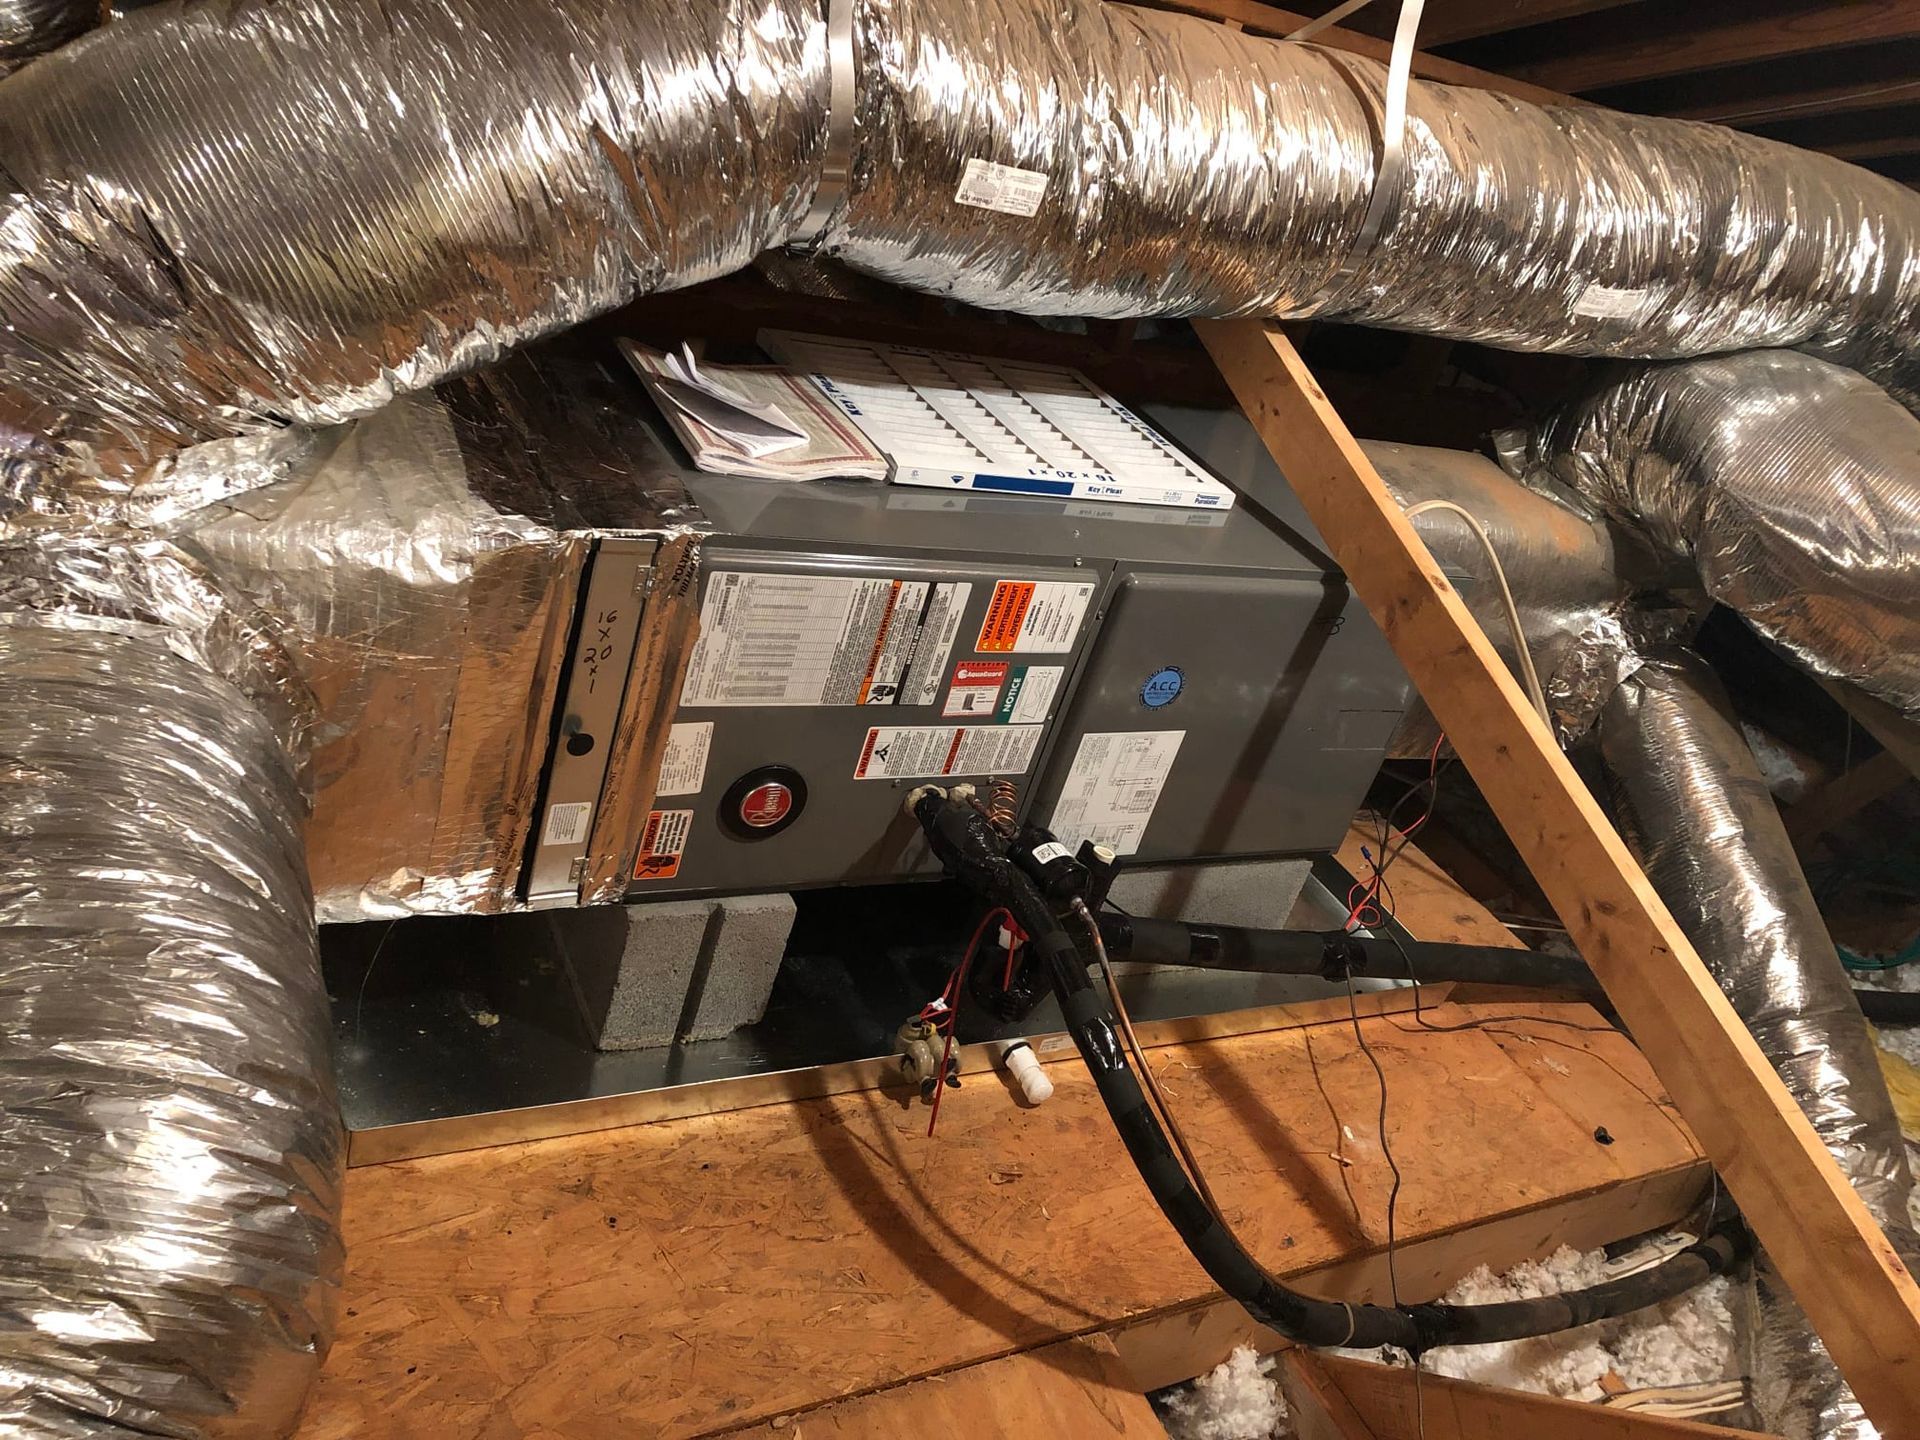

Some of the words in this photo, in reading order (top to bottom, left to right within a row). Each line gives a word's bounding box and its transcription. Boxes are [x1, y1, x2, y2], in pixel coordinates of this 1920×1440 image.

[1056, 470, 1078, 479] 20
[598, 609, 618, 624] 16
[983, 584, 1008, 641] WARNING
[995, 584, 1020, 641] AVERTISSEMENT
[1008, 587, 1032, 638] ADVERTENCIA
[583, 645, 612, 663] 20
[1002, 677, 1022, 713] NOTICE
[744, 787, 782, 822] Rheem
